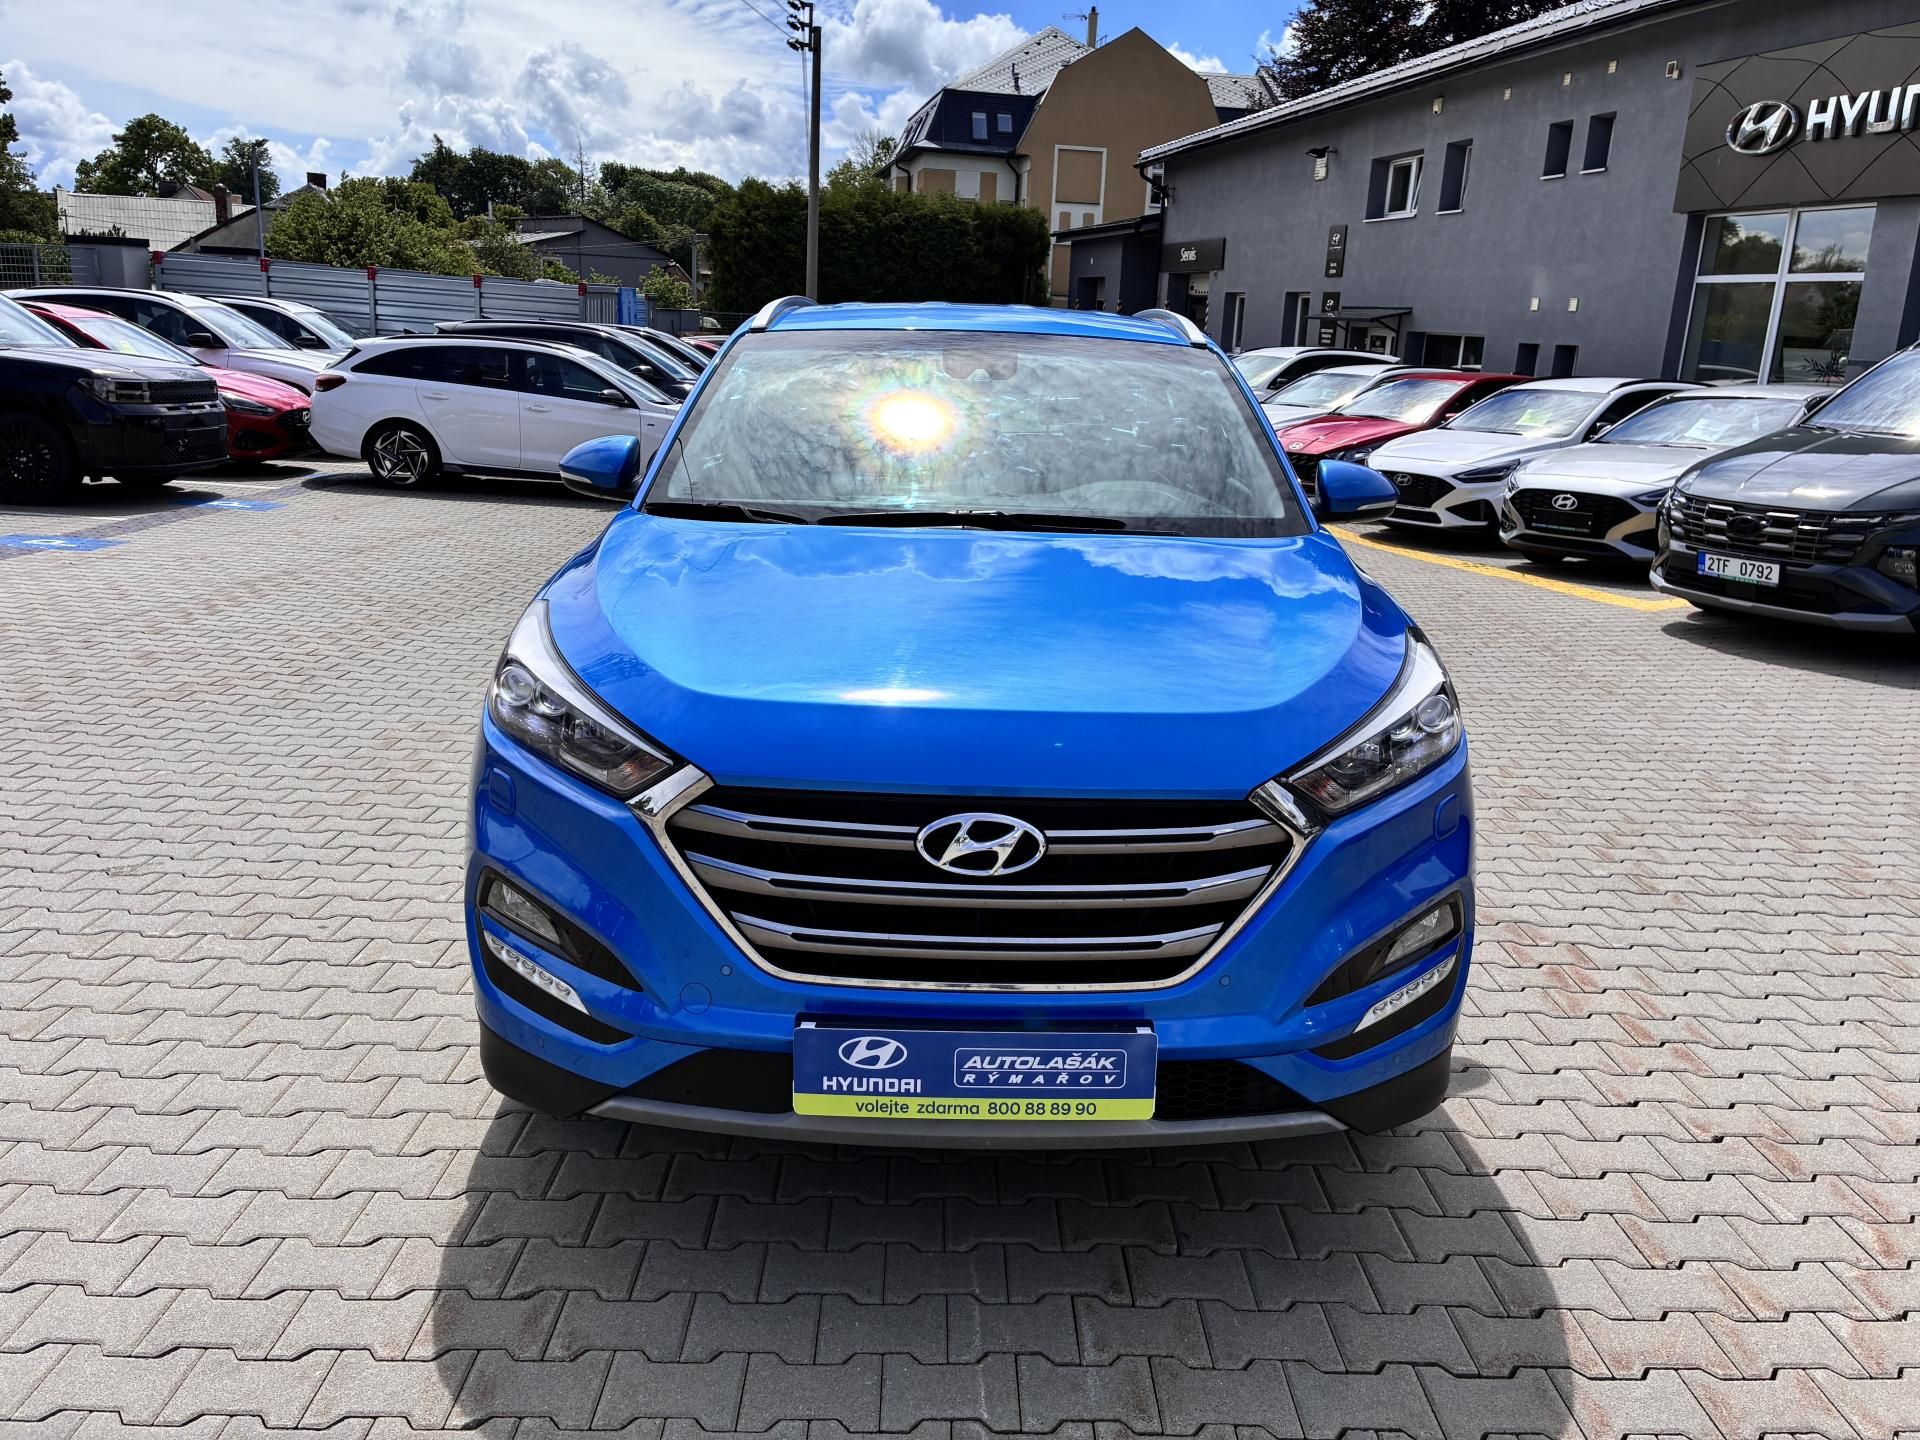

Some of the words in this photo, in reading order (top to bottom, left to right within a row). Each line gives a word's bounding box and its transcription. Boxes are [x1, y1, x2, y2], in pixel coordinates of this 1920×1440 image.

[1708, 557, 1730, 573] 2TF
[1740, 562, 1773, 580] 0792
[962, 1053, 1118, 1070] AUTOLAŠÁK
[822, 1076, 921, 1093] HYUNDAI
[855, 1100, 910, 1115] volejte
[916, 1101, 980, 1116] zdarma
[987, 1102, 1020, 1115] 800
[1025, 1102, 1046, 1115] 88
[1050, 1102, 1071, 1116] 89
[1075, 1102, 1097, 1116] 90
